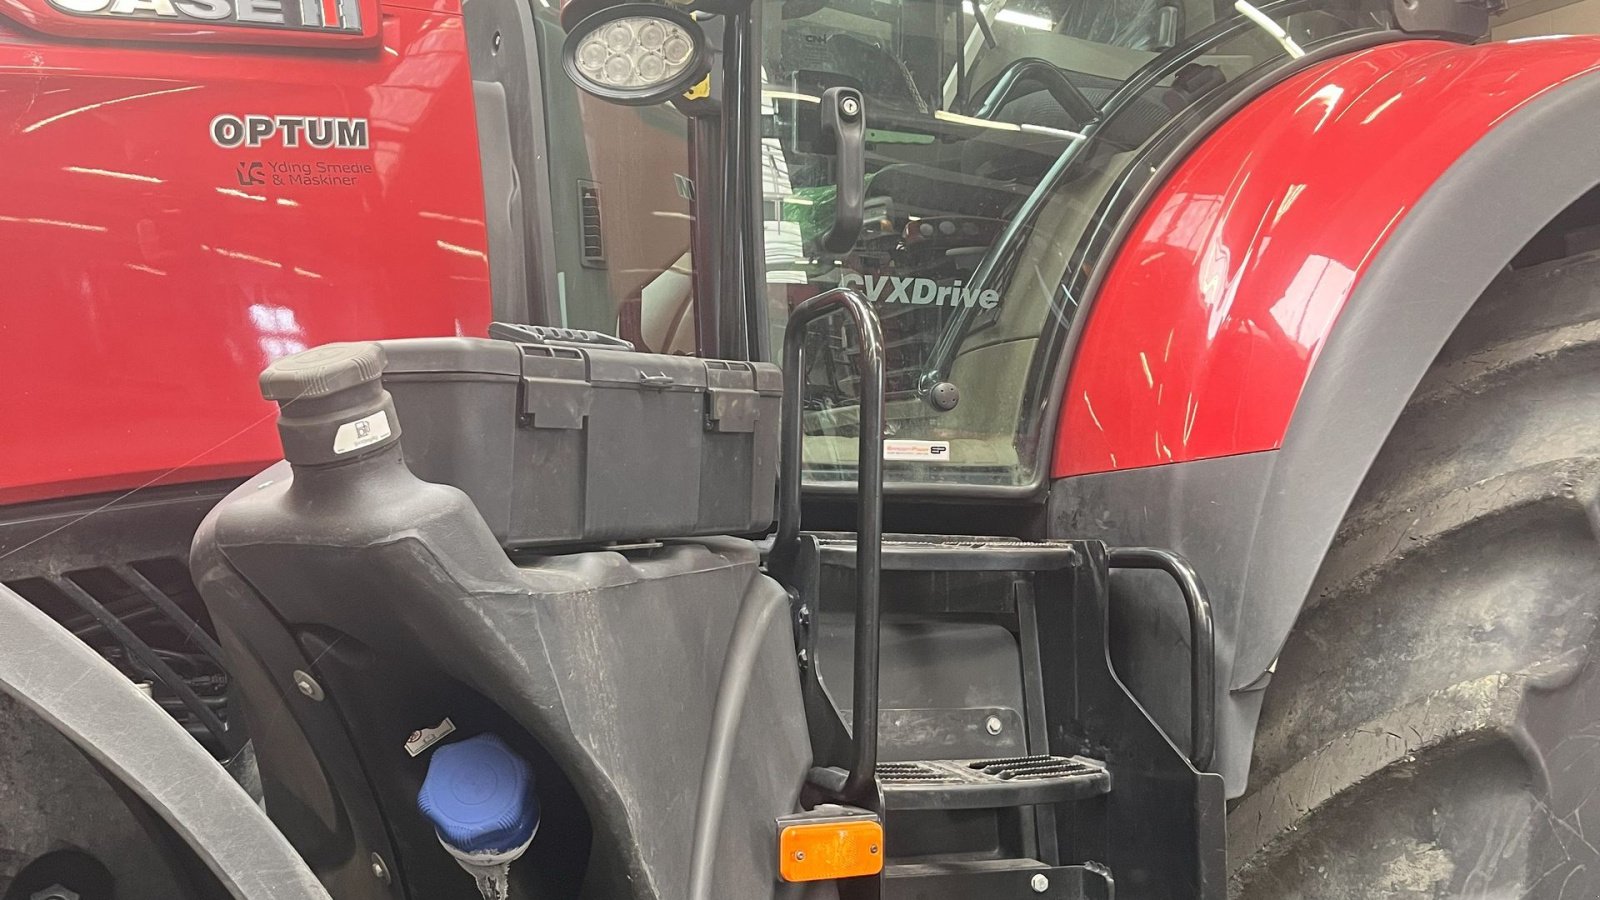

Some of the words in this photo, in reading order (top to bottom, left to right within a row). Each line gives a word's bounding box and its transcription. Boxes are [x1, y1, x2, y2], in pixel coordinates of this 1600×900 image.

[209, 114, 370, 150] OPTUM
[268, 161, 312, 175] Yding
[316, 162, 373, 175] Smedie
[272, 174, 285, 186] &
[289, 174, 358, 187] Maskiner
